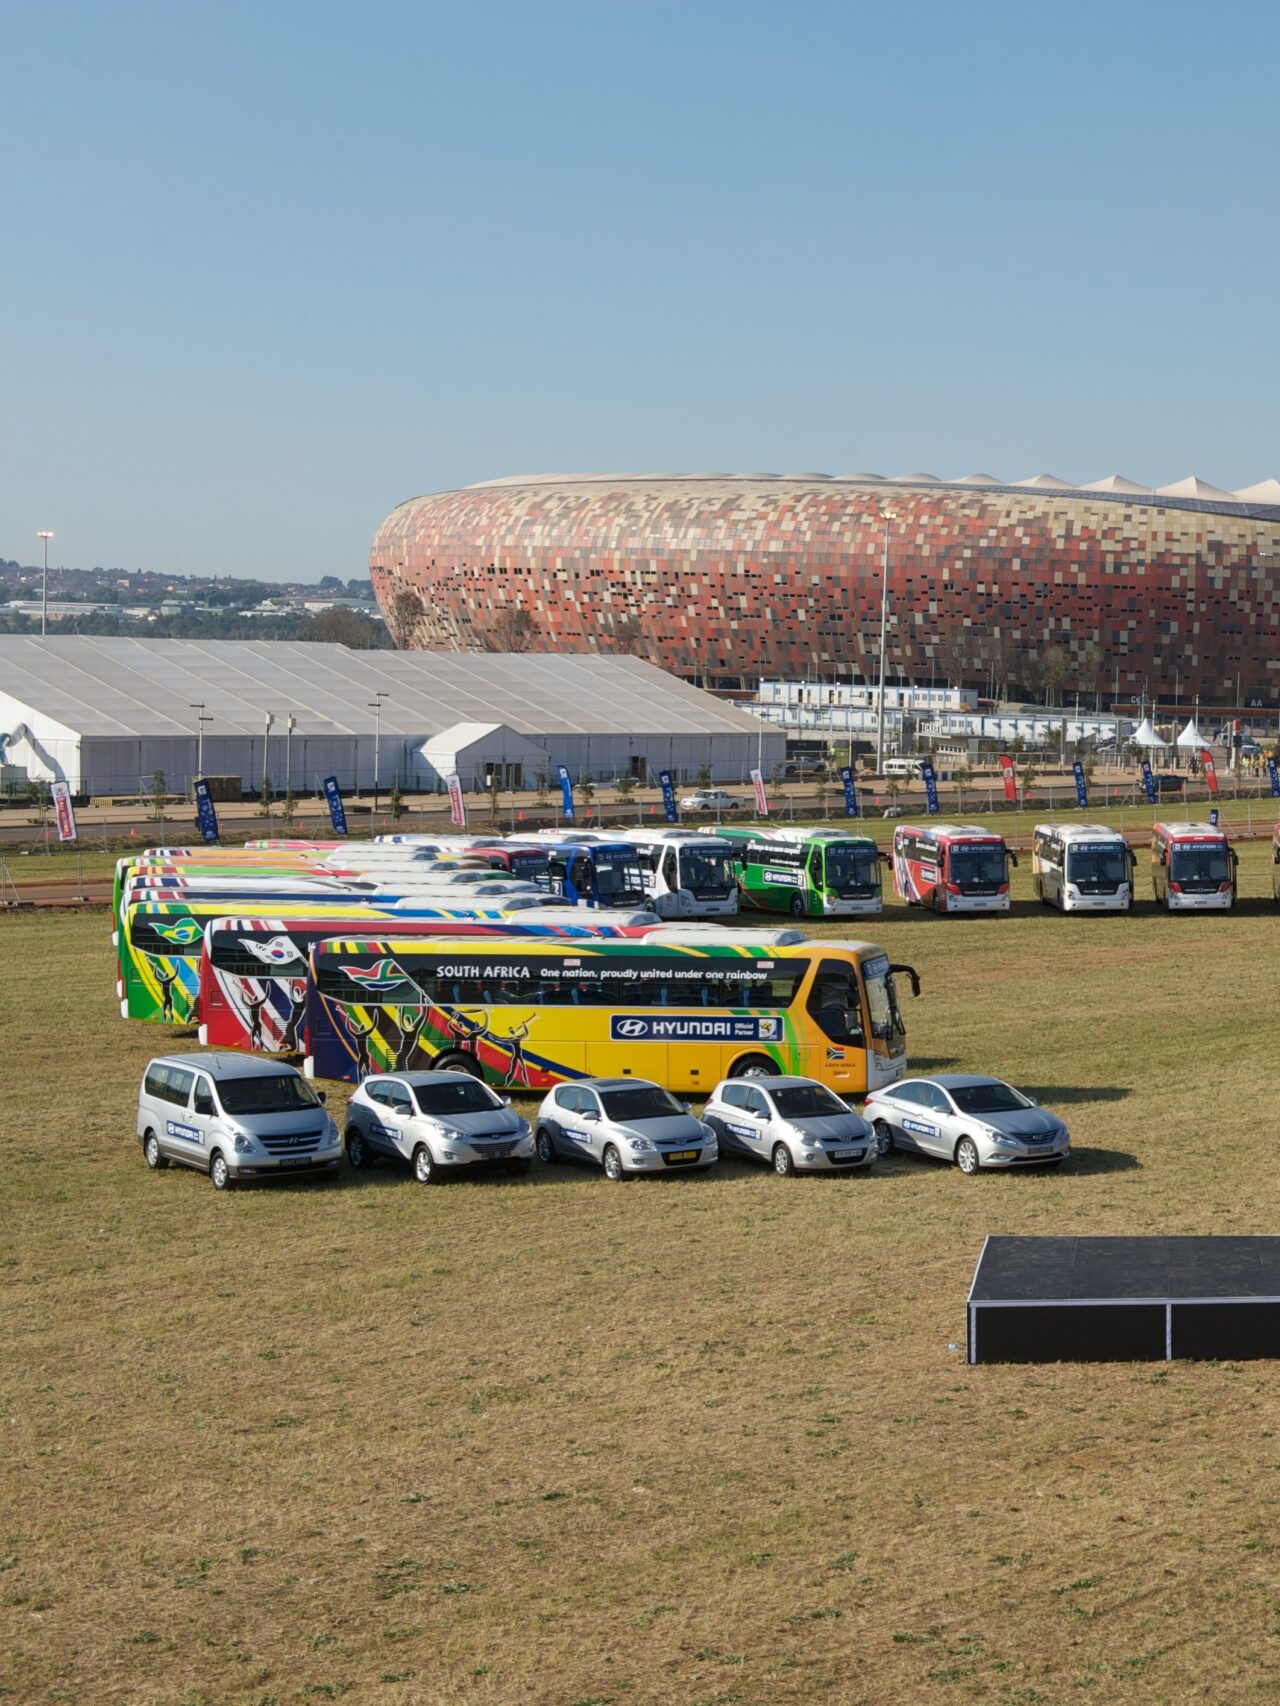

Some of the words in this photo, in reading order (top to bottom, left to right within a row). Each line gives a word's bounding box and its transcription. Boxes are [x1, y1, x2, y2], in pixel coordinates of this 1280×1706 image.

[1250, 698, 1263, 707] AA
[436, 965, 479, 977] SOUTH
[483, 965, 530, 978] AFRICA
[540, 968, 560, 977] One
[561, 967, 598, 979] nation,
[600, 968, 638, 980] proudly
[640, 968, 673, 979] united
[674, 969, 704, 979] under
[705, 971, 724, 980] one
[726, 969, 768, 980] rainbow
[652, 1021, 731, 1035] HYUNDAI
